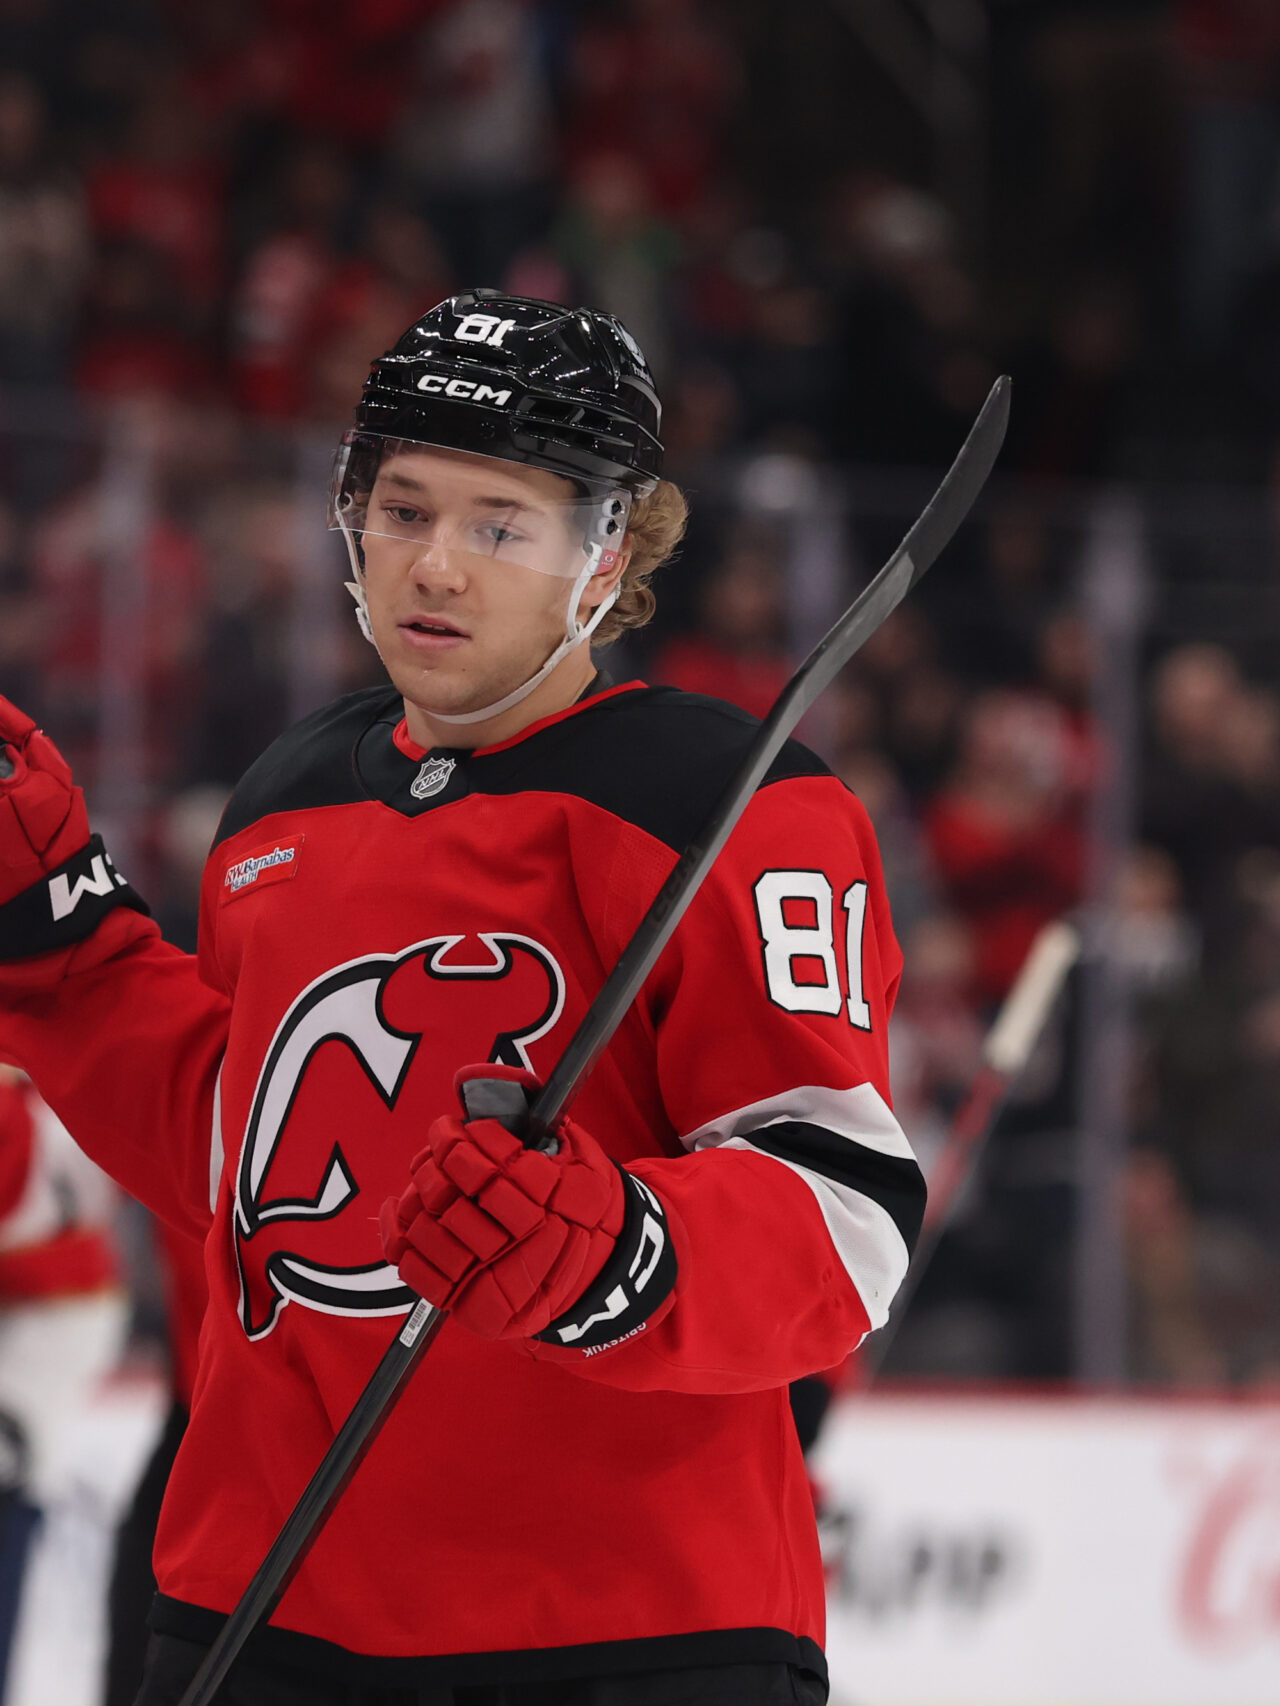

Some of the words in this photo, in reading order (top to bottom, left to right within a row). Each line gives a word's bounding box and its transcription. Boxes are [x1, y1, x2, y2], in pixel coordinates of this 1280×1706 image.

[453, 313, 516, 347] 81
[417, 374, 512, 406] CCM
[418, 768, 447, 791] NHL
[751, 868, 873, 1034] 81
